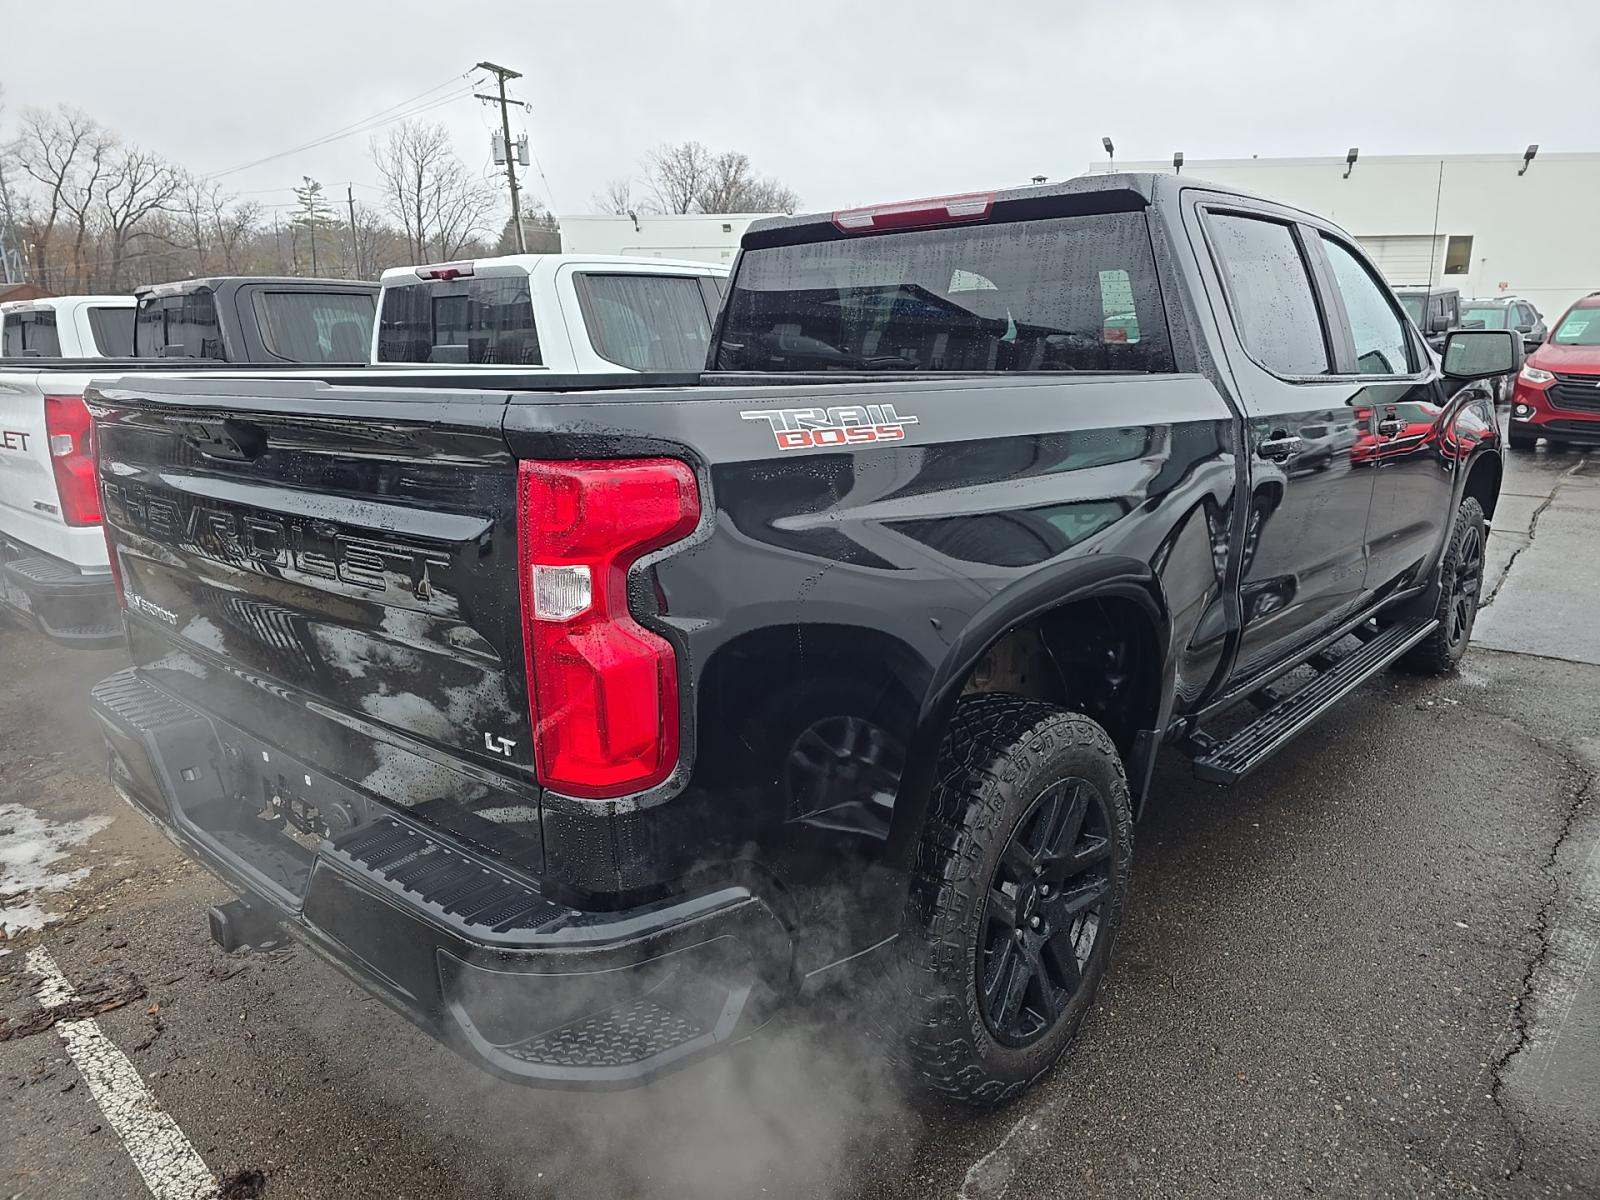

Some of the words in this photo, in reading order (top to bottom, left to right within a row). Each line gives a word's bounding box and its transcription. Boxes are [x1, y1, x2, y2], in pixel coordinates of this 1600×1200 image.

[740, 404, 918, 431] TRAIL
[776, 425, 905, 450] BOSS
[103, 482, 454, 602] CHEVROLET
[484, 732, 517, 757] LT
